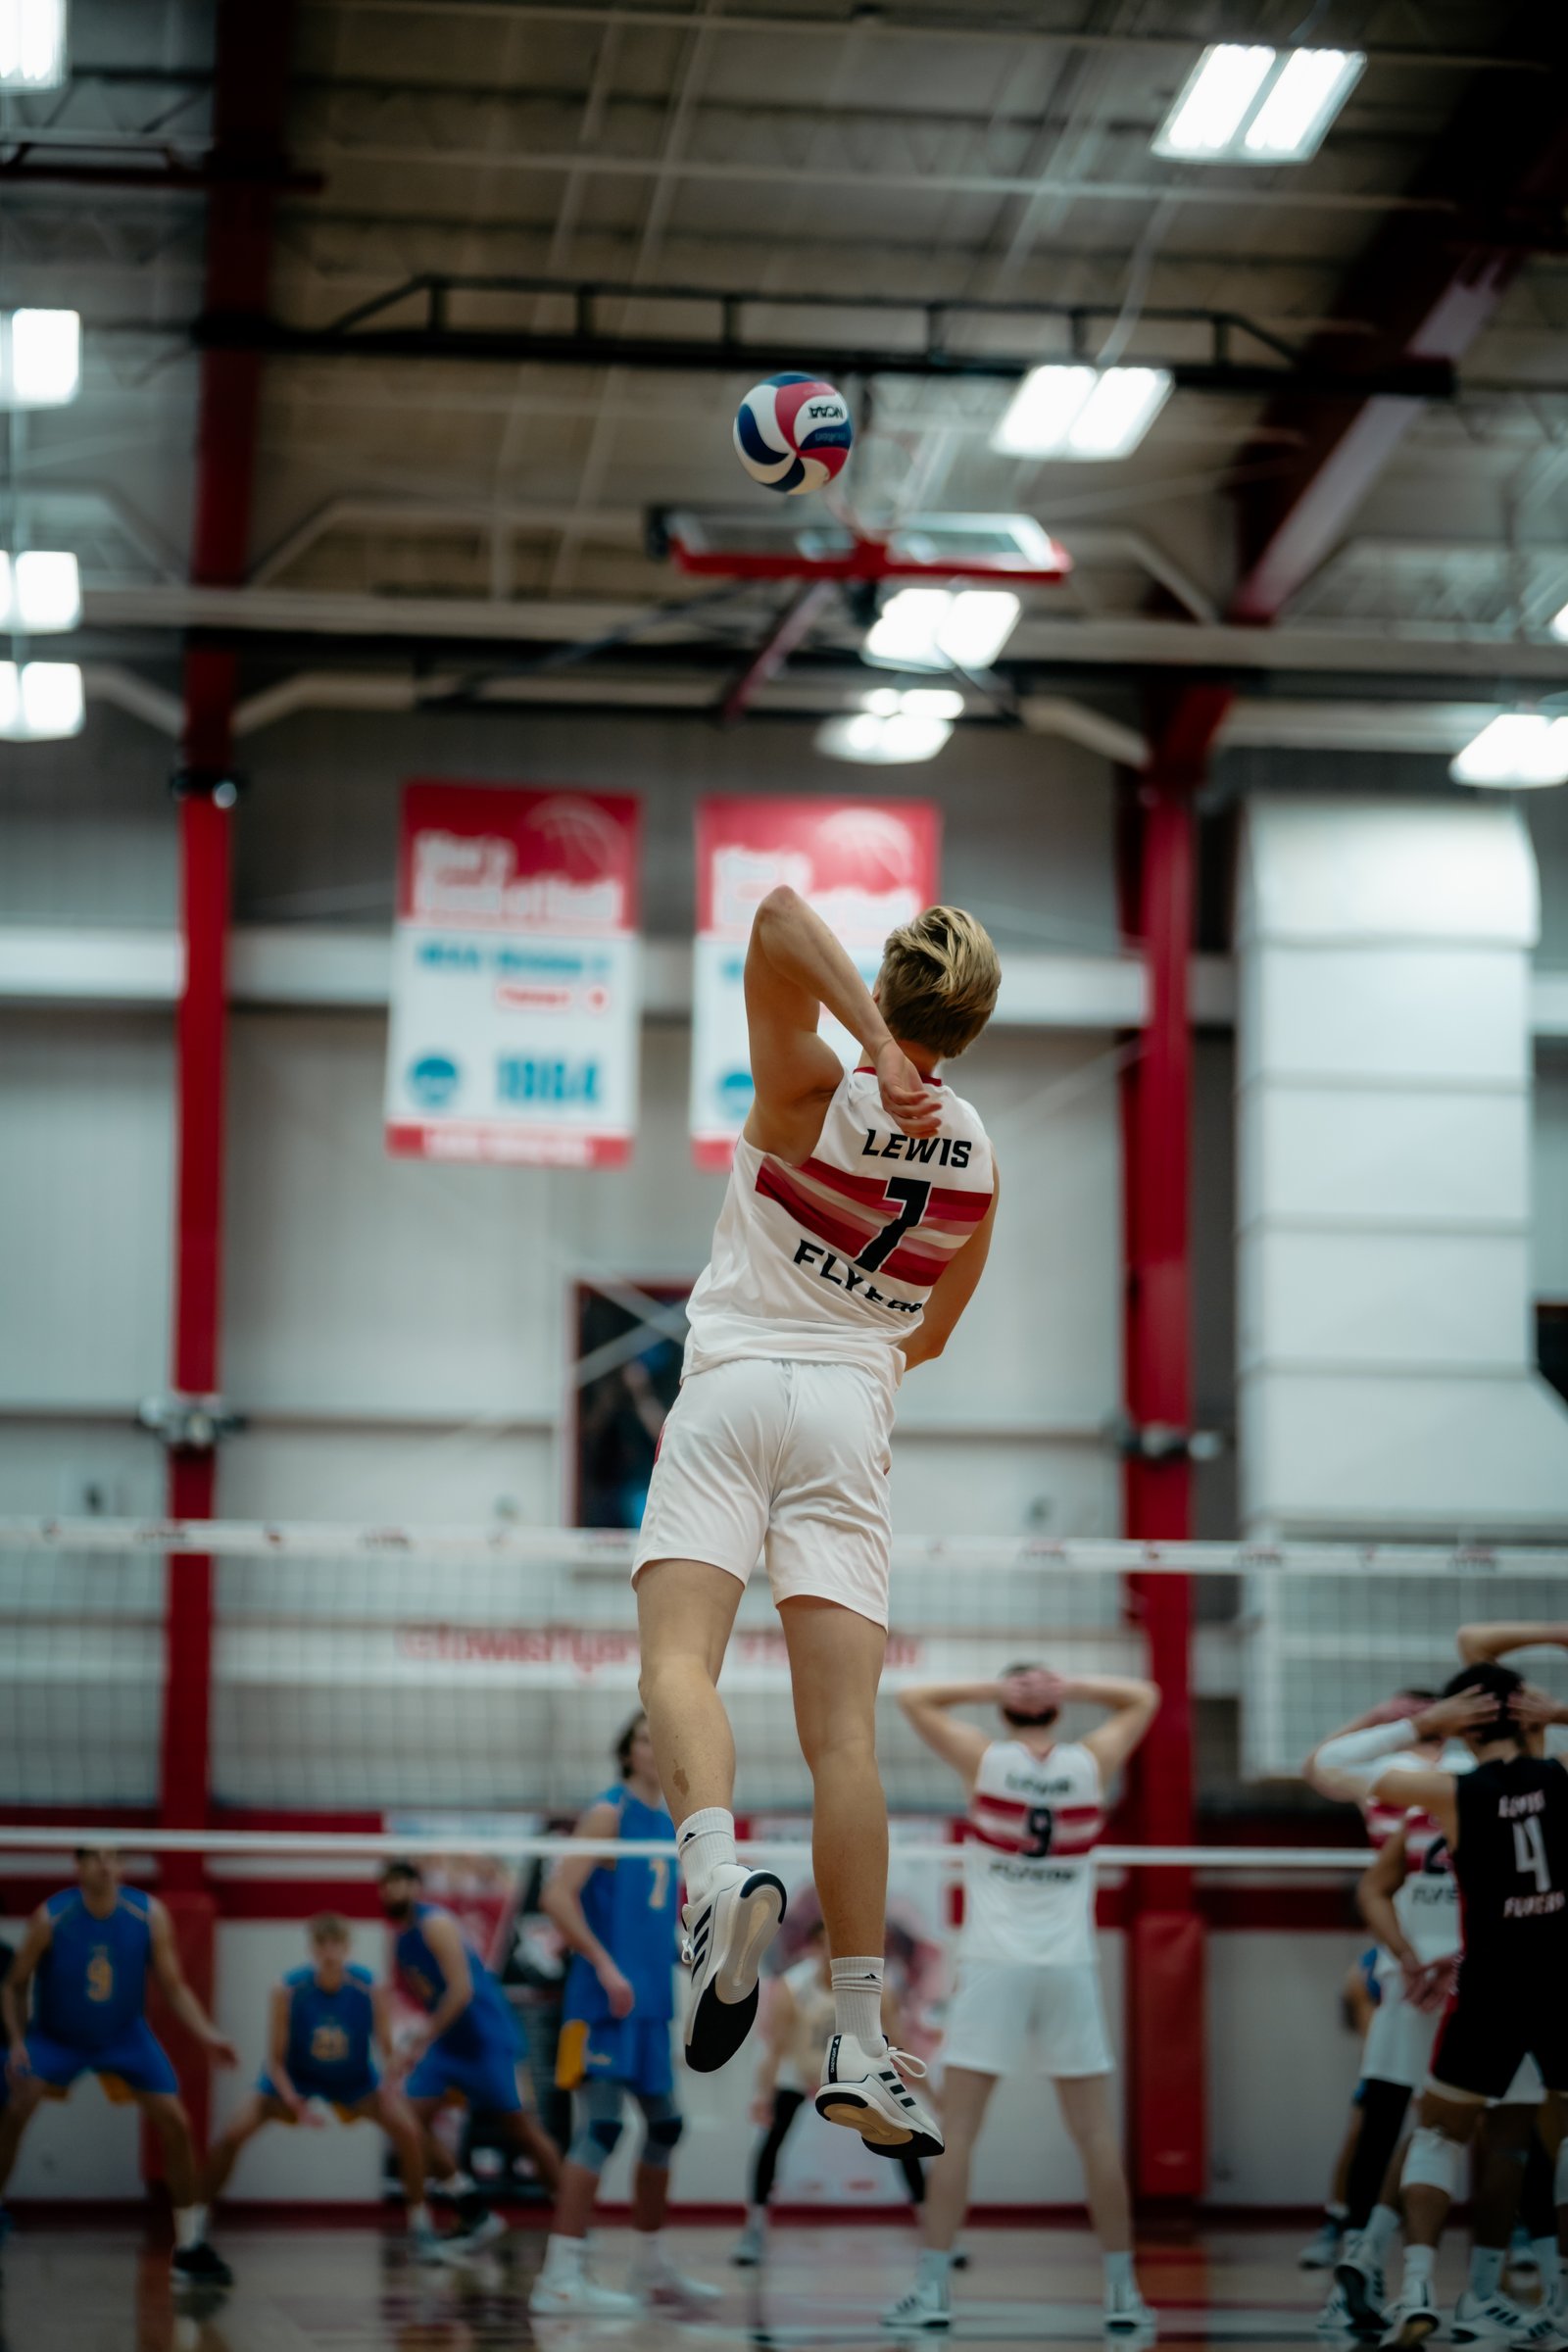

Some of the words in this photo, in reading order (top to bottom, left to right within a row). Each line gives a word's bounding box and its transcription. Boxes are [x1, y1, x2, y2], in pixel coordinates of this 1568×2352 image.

[808, 406, 844, 419] NCAA
[862, 1129, 972, 1168] LEWIS
[854, 1176, 932, 1273] 7
[1022, 1808, 1054, 1858] 9
[1512, 1815, 1551, 1892] 4
